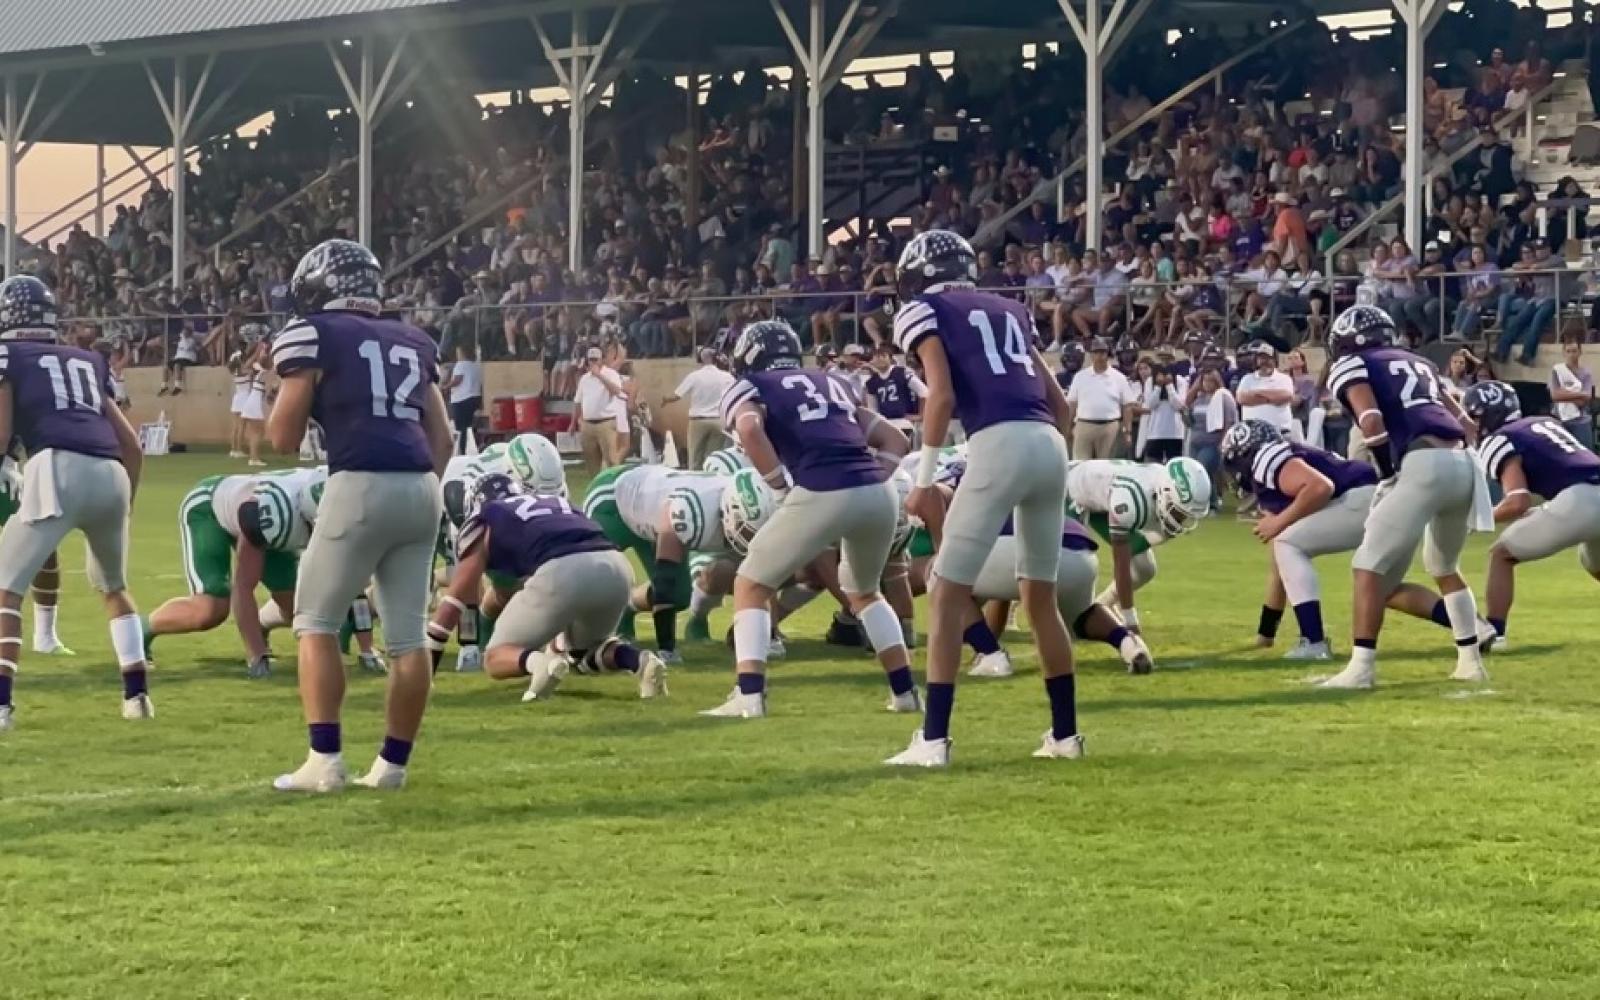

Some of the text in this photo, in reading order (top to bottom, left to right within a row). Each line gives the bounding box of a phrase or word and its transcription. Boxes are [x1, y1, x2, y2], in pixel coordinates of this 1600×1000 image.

[967, 309, 1036, 376] 14
[38, 355, 102, 415] 10
[359, 340, 422, 423] 12
[781, 374, 859, 424] 34
[877, 384, 899, 402] 72
[671, 510, 688, 532] 70
